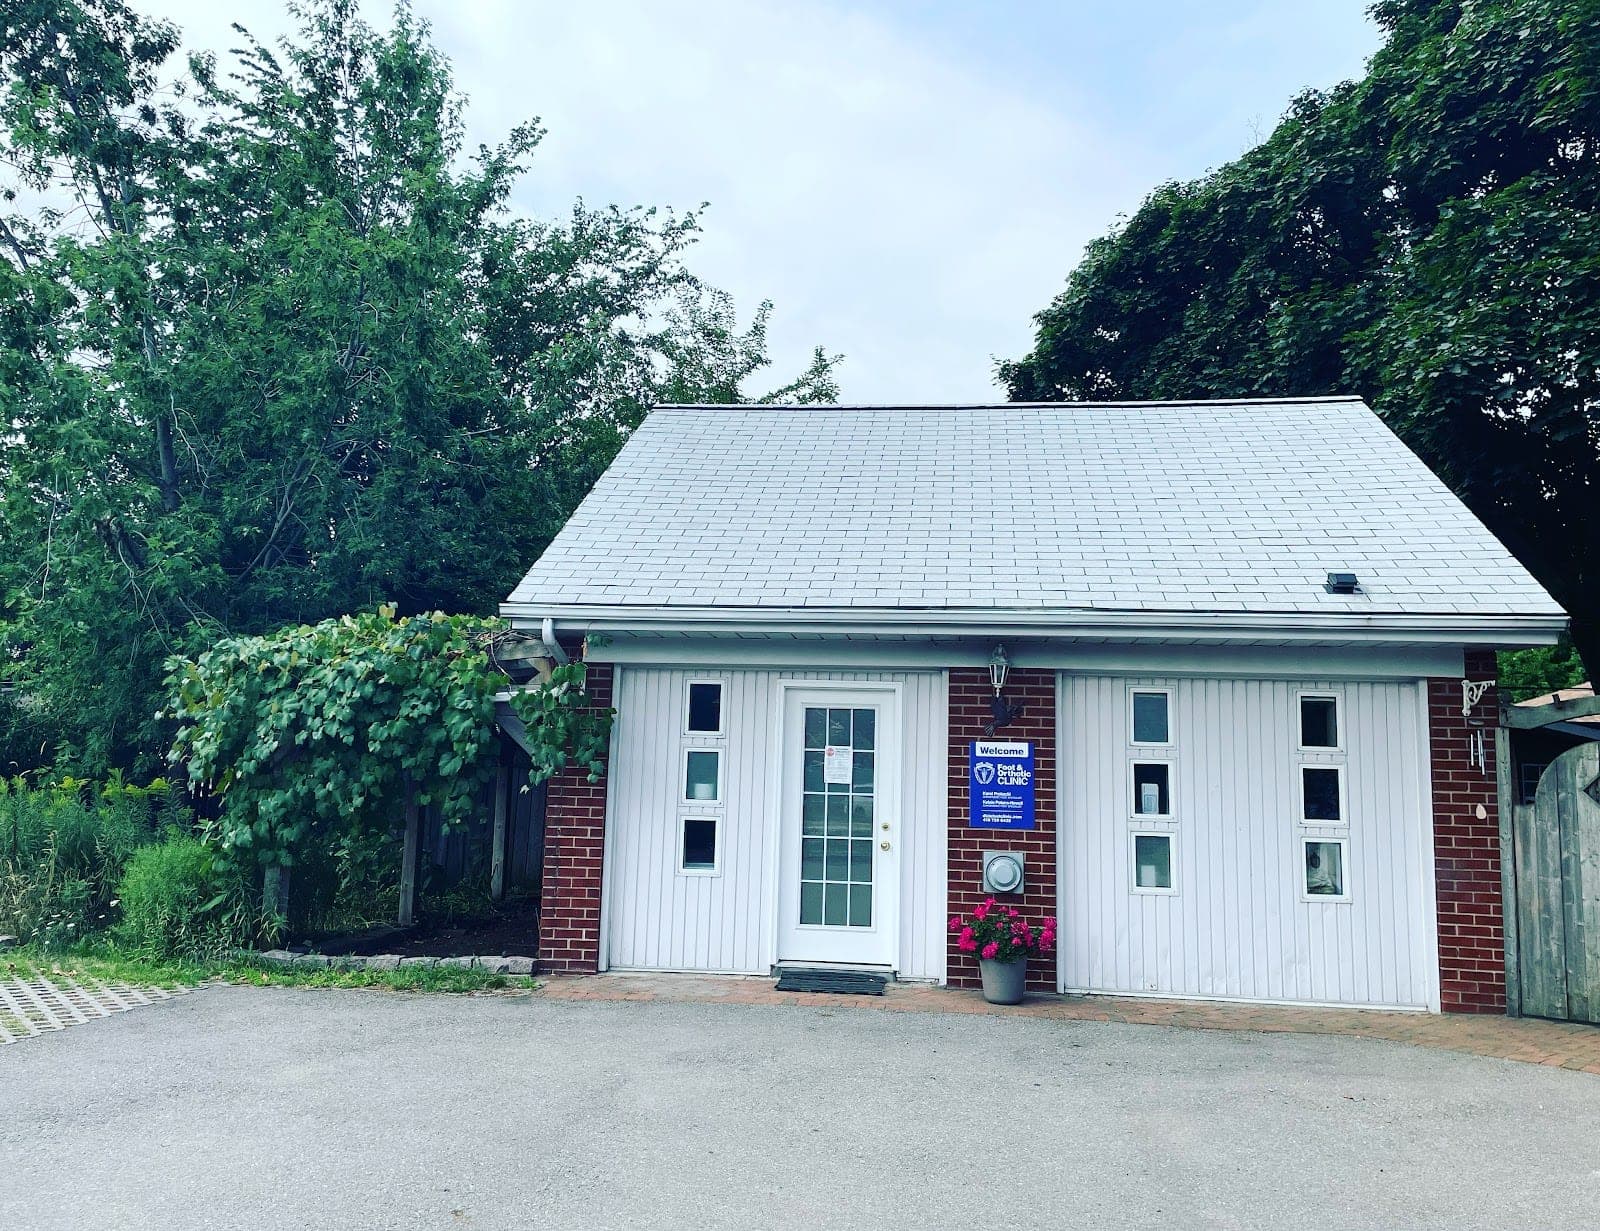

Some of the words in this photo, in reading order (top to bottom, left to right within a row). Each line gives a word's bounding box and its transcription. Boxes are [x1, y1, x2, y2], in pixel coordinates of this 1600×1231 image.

[980, 747, 1024, 755] Welcome
[997, 769, 1031, 777] Orthotic
[997, 777, 1029, 785] CLINIC
